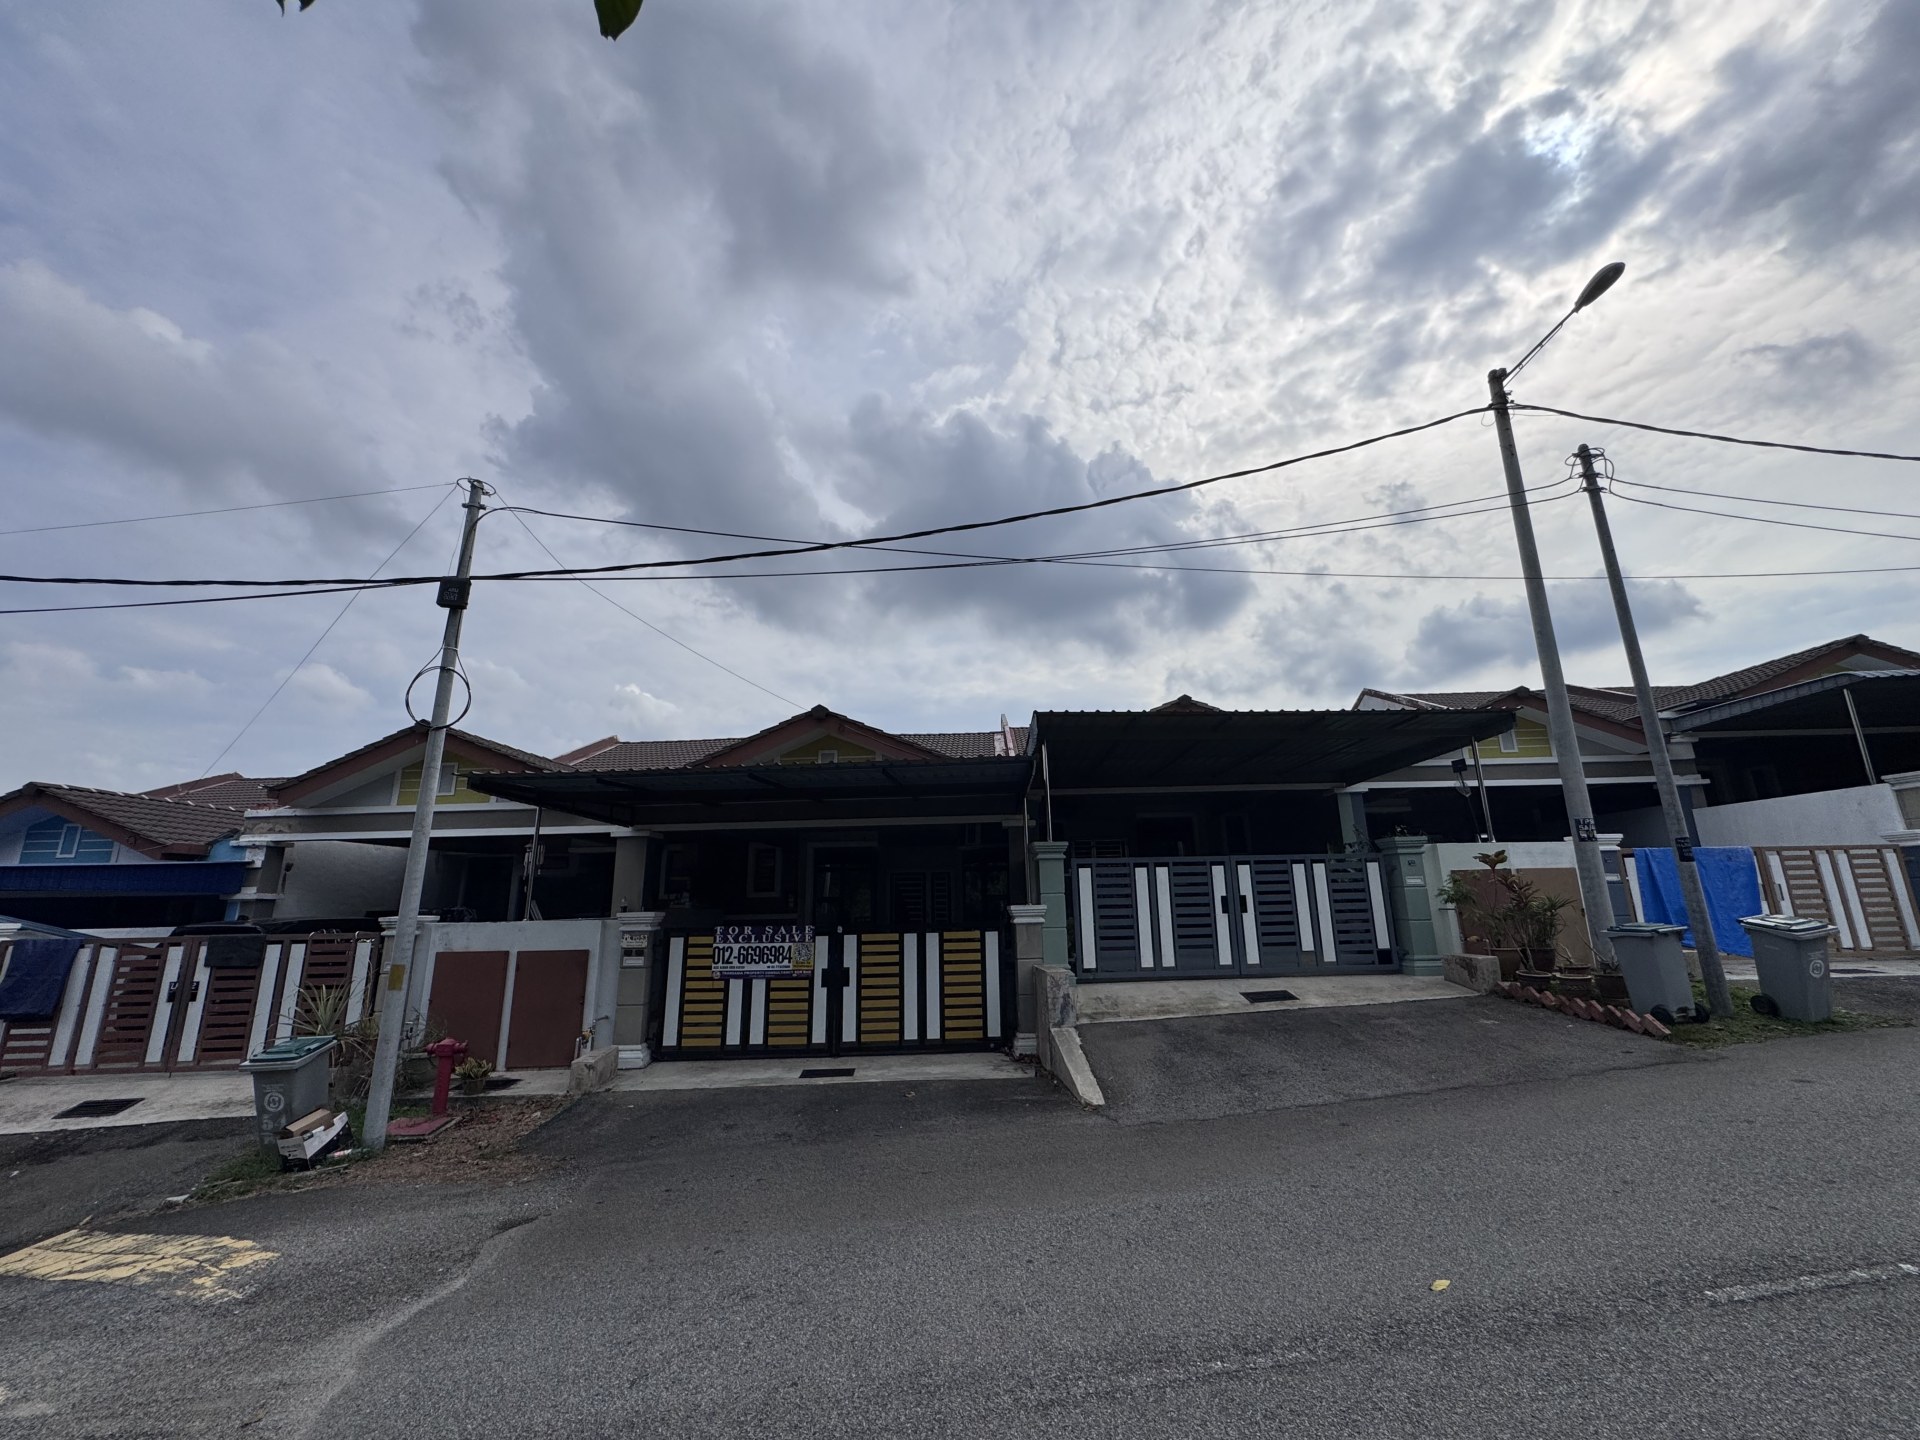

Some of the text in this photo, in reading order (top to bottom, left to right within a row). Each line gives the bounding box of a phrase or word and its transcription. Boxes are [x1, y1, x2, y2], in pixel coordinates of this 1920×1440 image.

[714, 925, 815, 935] FOR SALE
[715, 934, 813, 943] EXCLUSIVE
[713, 945, 792, 965] 012-6696984
